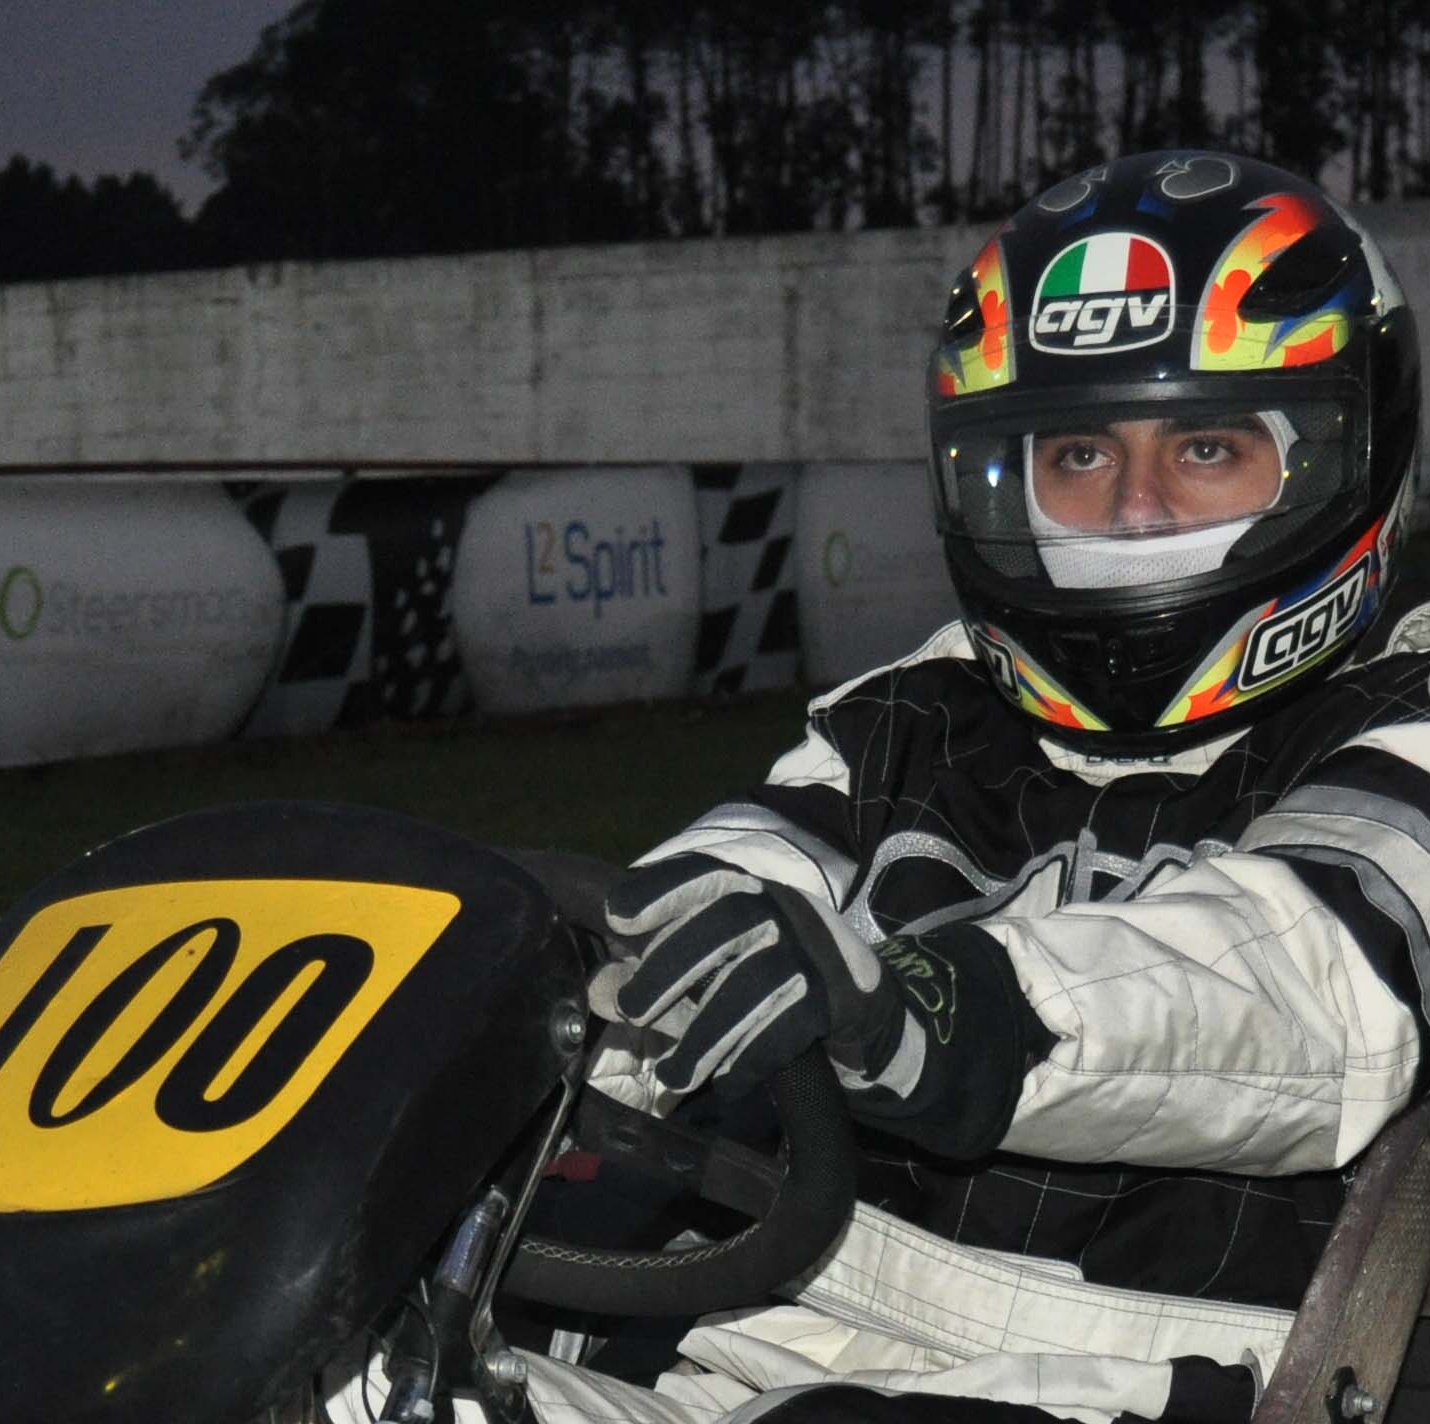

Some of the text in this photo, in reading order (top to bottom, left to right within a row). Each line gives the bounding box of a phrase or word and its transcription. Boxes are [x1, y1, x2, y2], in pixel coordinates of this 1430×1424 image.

[1035, 291, 1169, 345] agv
[564, 519, 666, 619] Spirit
[1267, 573, 1365, 666] agv
